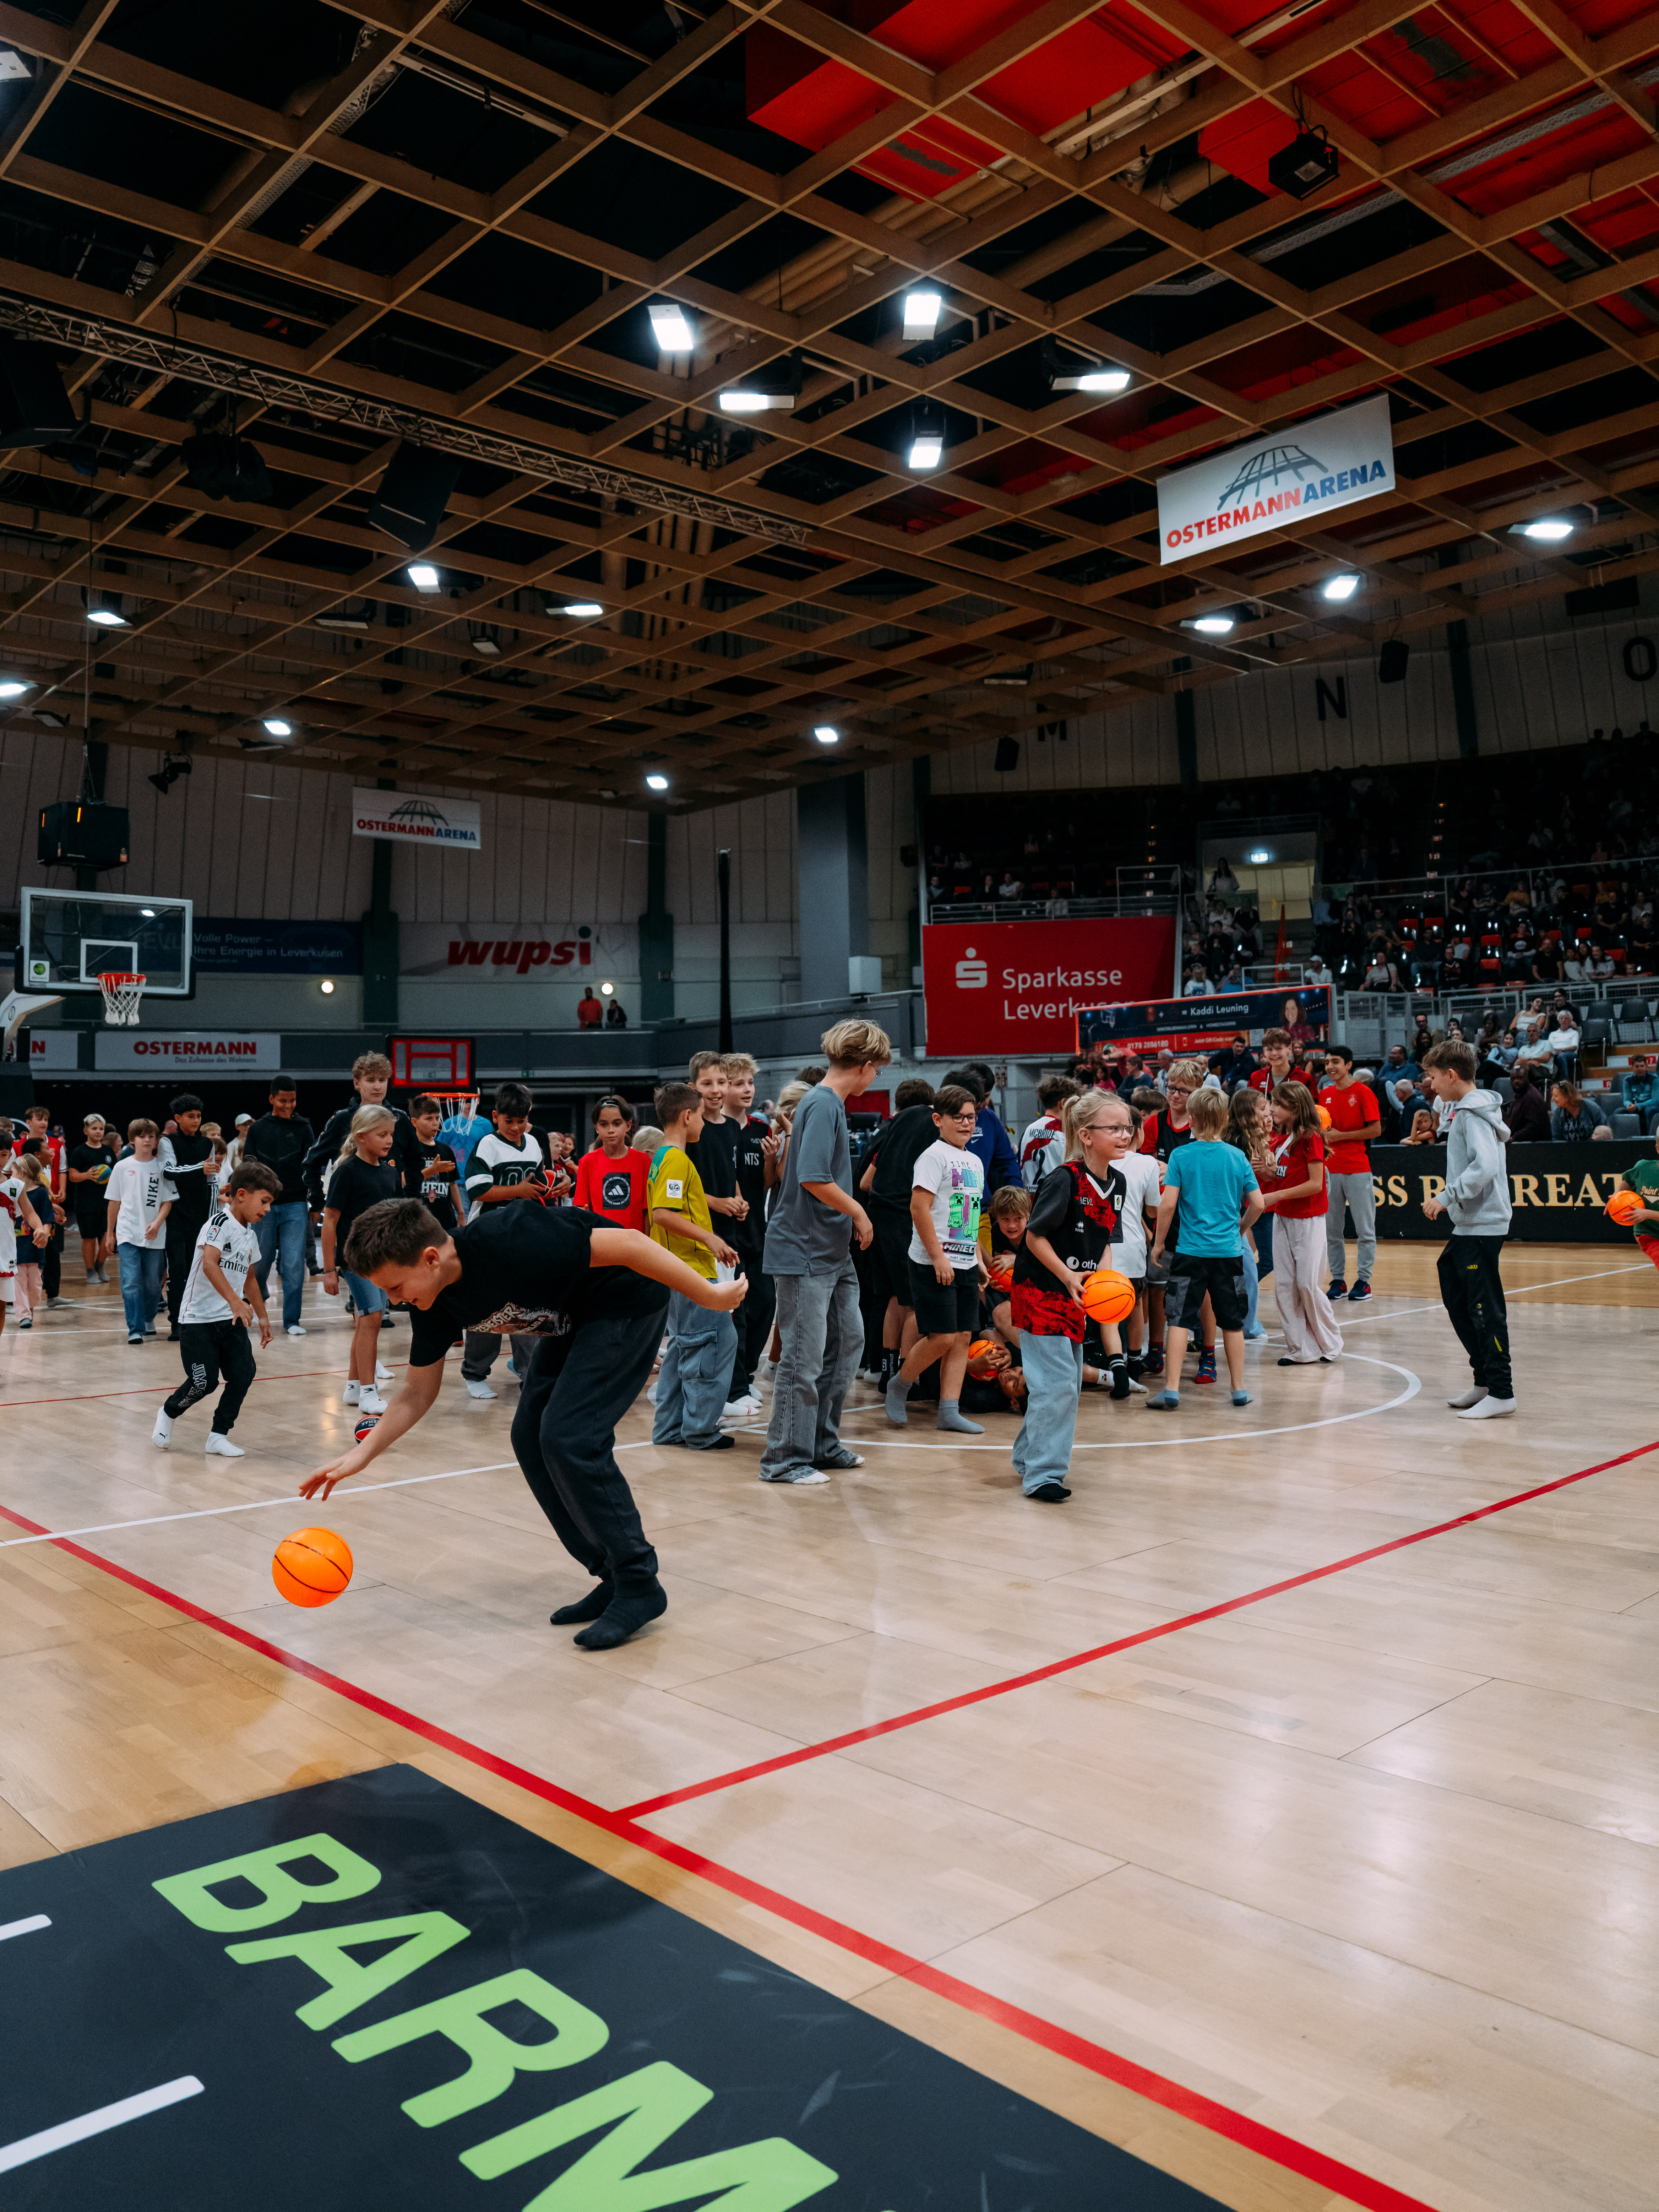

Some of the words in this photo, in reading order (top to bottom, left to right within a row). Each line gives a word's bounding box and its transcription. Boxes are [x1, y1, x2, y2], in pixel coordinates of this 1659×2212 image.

[1166, 460, 1386, 549] OSTERMANNARENA
[1316, 676, 1347, 721] N
[356, 818, 477, 841] OSTERMANNARENA
[194, 933, 221, 943] Volle
[225, 934, 261, 944] Power
[194, 946, 216, 955] Ihre
[220, 946, 263, 958] Energie
[267, 947, 276, 956] in
[281, 947, 343, 957] Leverkusen
[448, 926, 591, 974] wupsi
[1002, 966, 1122, 994] Sparkasse
[1004, 996, 1135, 1020] Leverk
[1190, 1005, 1214, 1016] Kaddi
[1216, 1003, 1249, 1015] Leuning
[134, 1041, 256, 1055] OSTERMANN
[1028, 1128, 1057, 1139] MCBRIDE
[744, 1153, 759, 1165] NTS
[950, 1161, 971, 1169] TIME
[146, 1177, 159, 1207] NIKE
[1372, 1175, 1408, 1207] SS
[1640, 1185, 1659, 1195] Point
[218, 1257, 248, 1275] Emiraes
[236, 1252, 245, 1262] Fly
[152, 1832, 839, 2212] BARM
